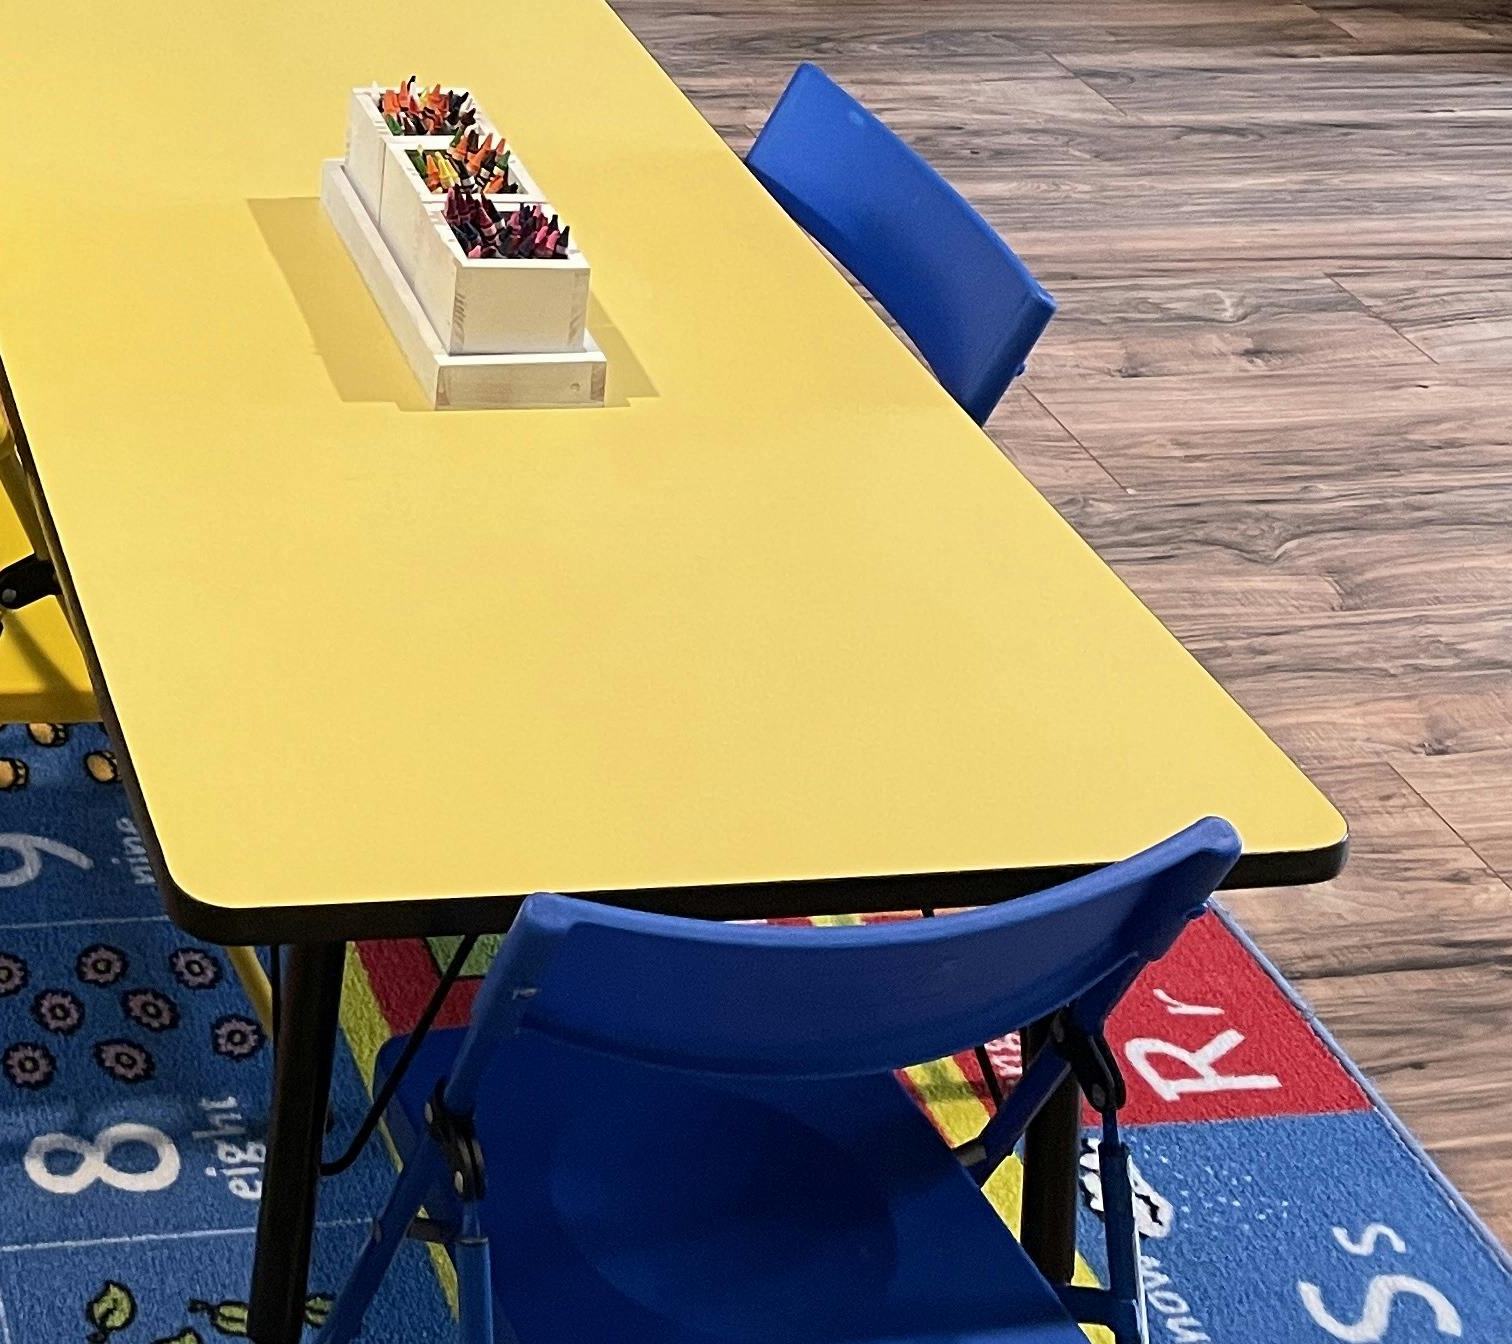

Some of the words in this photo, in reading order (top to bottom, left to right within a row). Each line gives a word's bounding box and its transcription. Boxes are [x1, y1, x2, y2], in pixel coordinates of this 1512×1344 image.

[1125, 989, 1282, 1102] Rr
[24, 1123, 180, 1194] 8
[192, 1095, 266, 1200] eight
